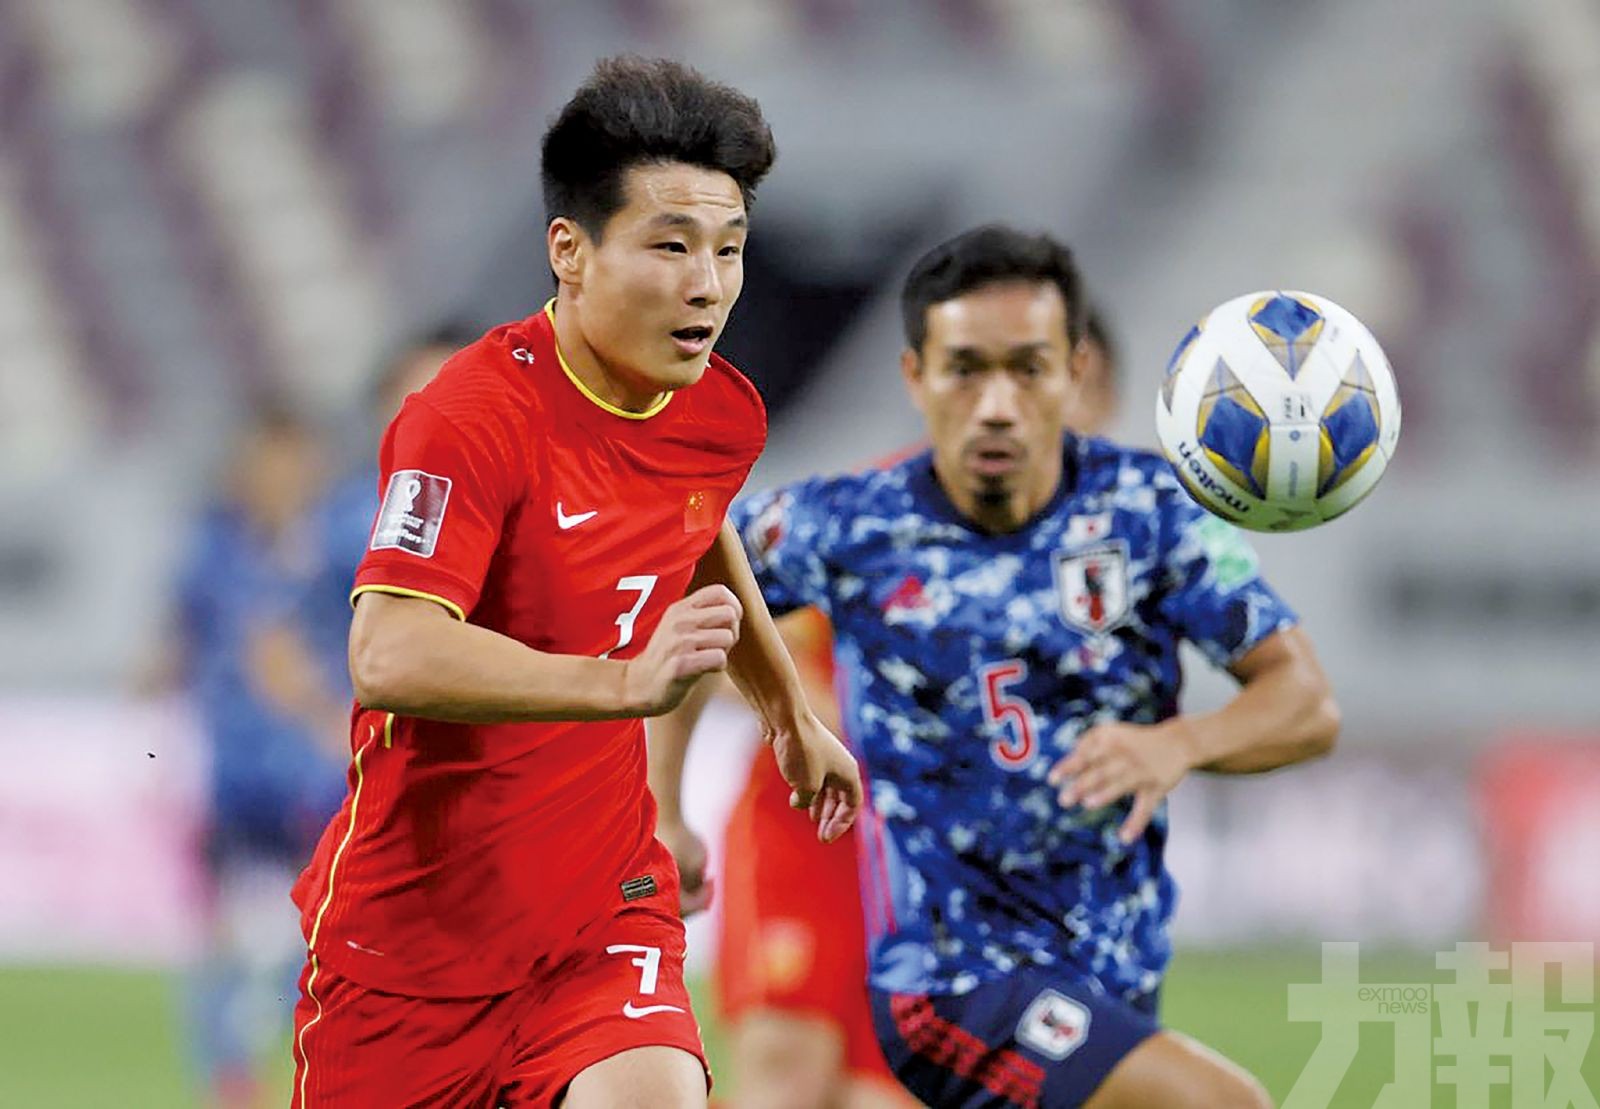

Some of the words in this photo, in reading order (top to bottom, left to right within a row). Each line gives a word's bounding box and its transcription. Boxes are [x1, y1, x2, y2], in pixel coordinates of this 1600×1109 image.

[1179, 441, 1250, 513] molten
[598, 575, 659, 660] 7
[977, 658, 1040, 772] 5
[605, 943, 662, 995] 7
